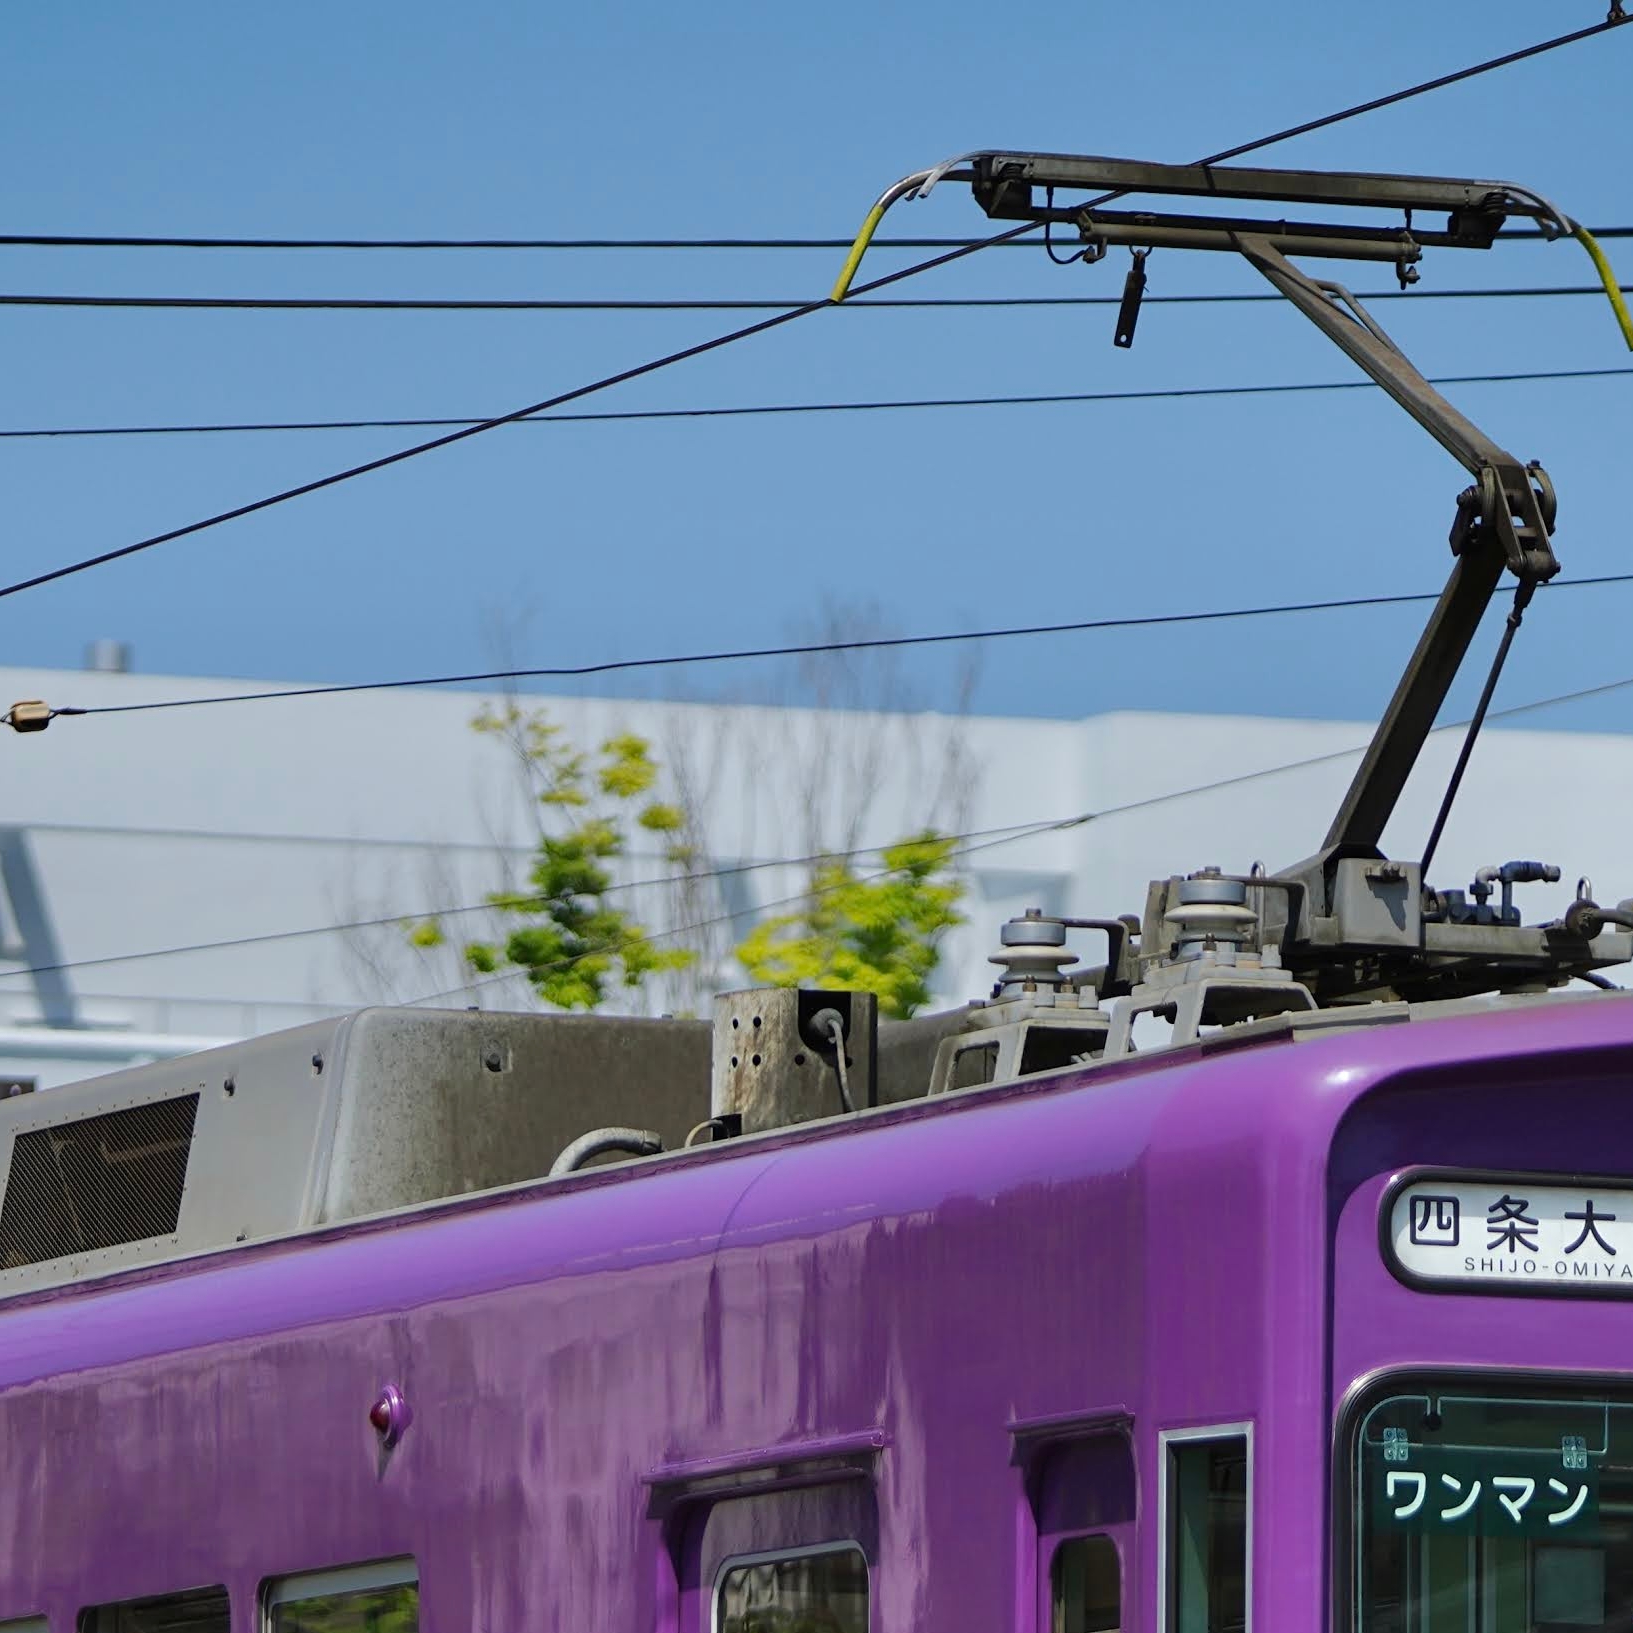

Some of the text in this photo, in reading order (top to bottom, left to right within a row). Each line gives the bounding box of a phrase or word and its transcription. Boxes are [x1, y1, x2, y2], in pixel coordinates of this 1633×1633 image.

[1464, 1257, 1633, 1279] SHIJO-OMIYA
[1386, 1471, 1589, 1524] ワンマン
